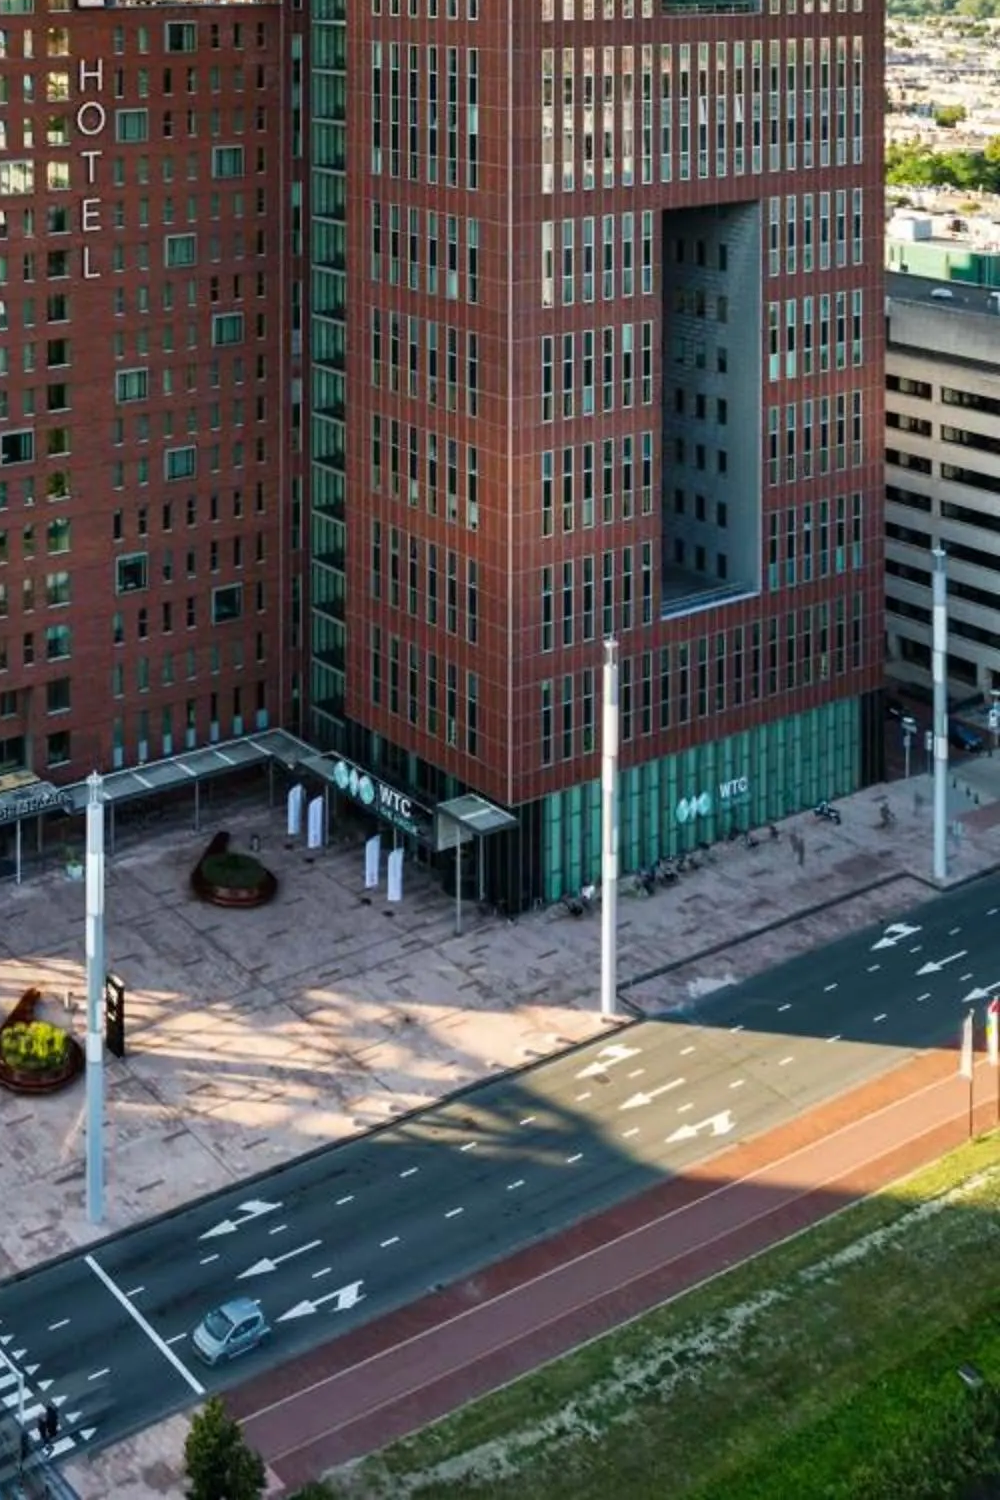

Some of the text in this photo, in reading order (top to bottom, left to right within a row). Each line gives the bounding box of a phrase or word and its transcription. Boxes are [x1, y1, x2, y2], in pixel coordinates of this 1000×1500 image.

[77, 58, 106, 279] HOTEL
[379, 784, 412, 818] WTC
[719, 776, 748, 798] WTC
